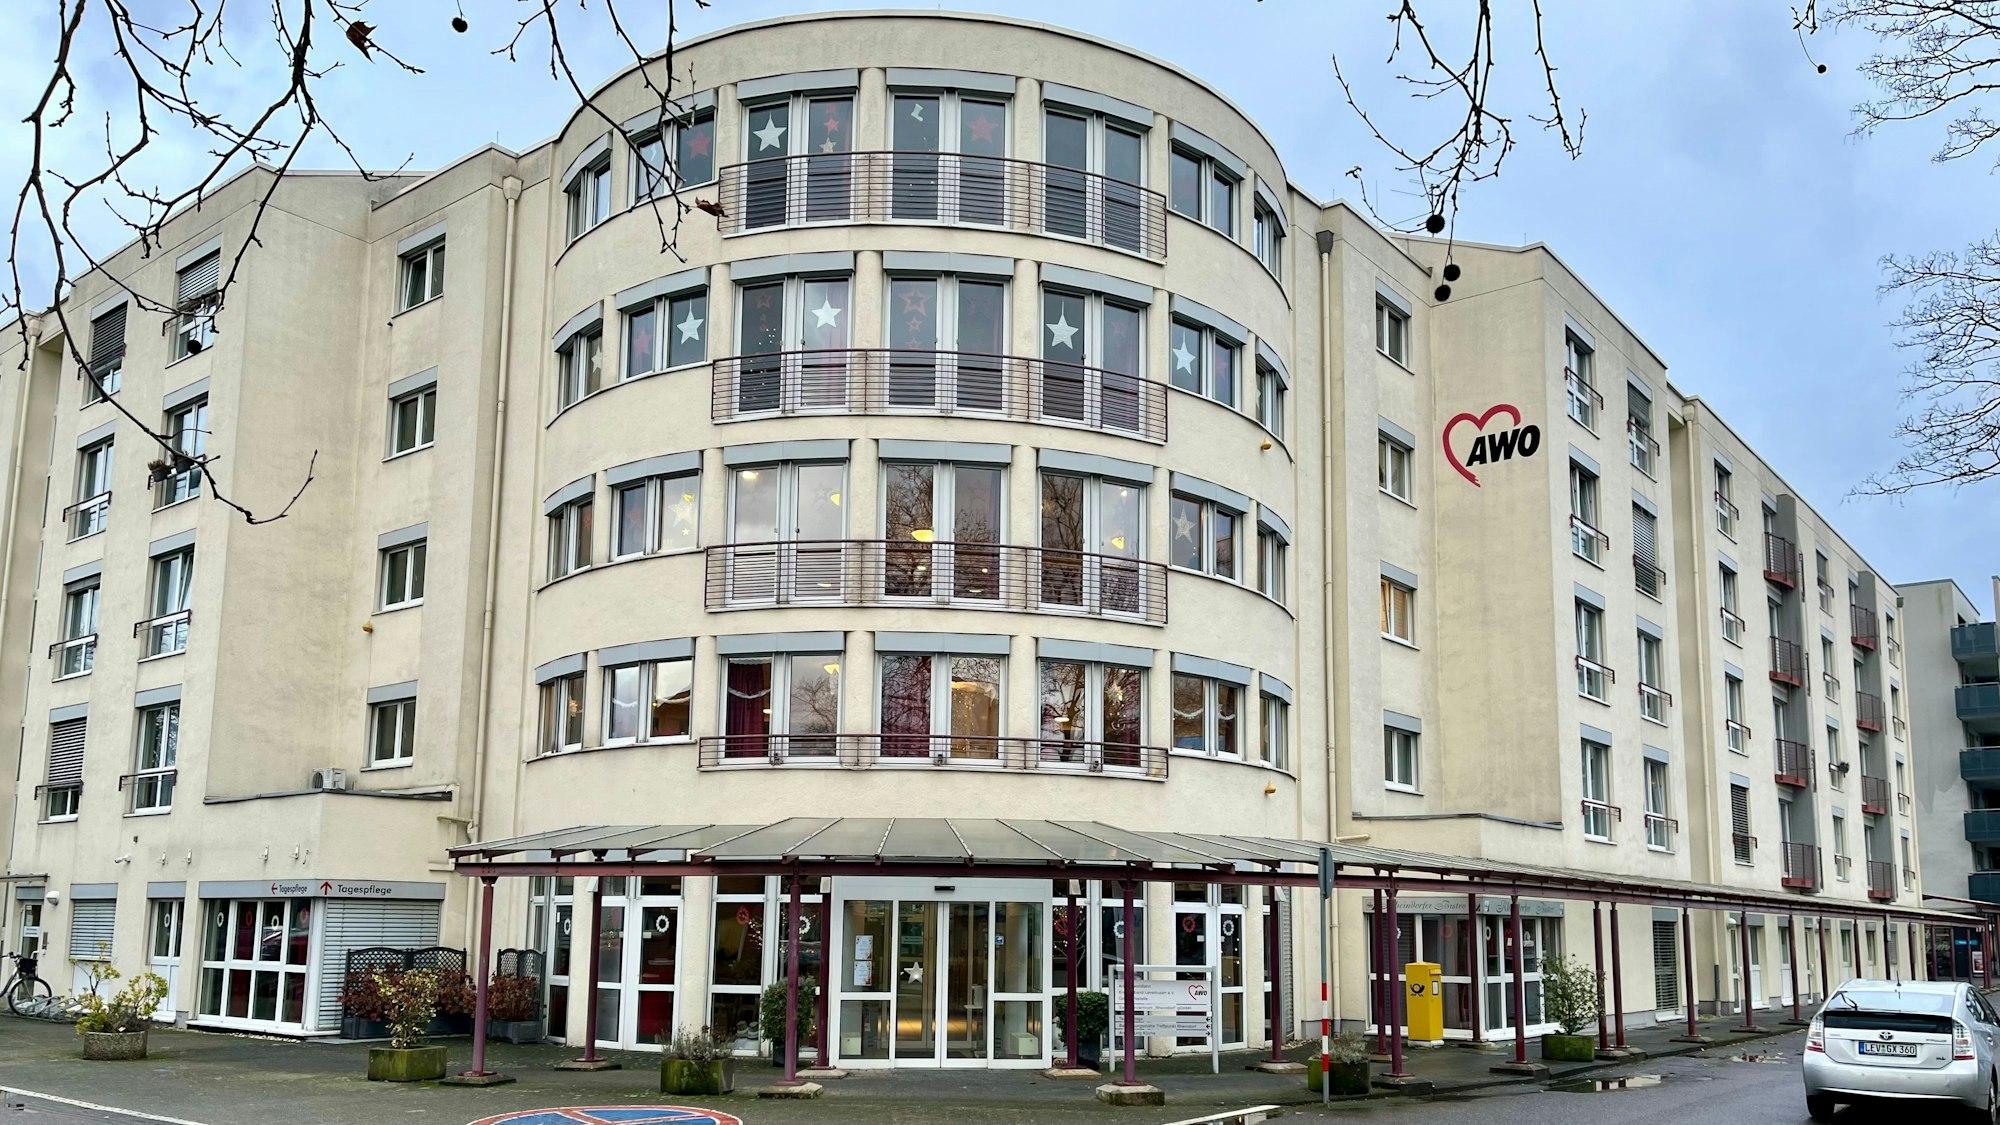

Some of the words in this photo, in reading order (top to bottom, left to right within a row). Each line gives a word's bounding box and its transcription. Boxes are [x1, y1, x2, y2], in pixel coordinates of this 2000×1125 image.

[1466, 424, 1540, 467] AWO
[279, 884, 308, 894] Tagespflege
[337, 884, 392, 895] Tagespflege
[1865, 1043, 1881, 1053] LEV
[1886, 1045, 1897, 1053] GX
[1899, 1045, 1915, 1054] 360
